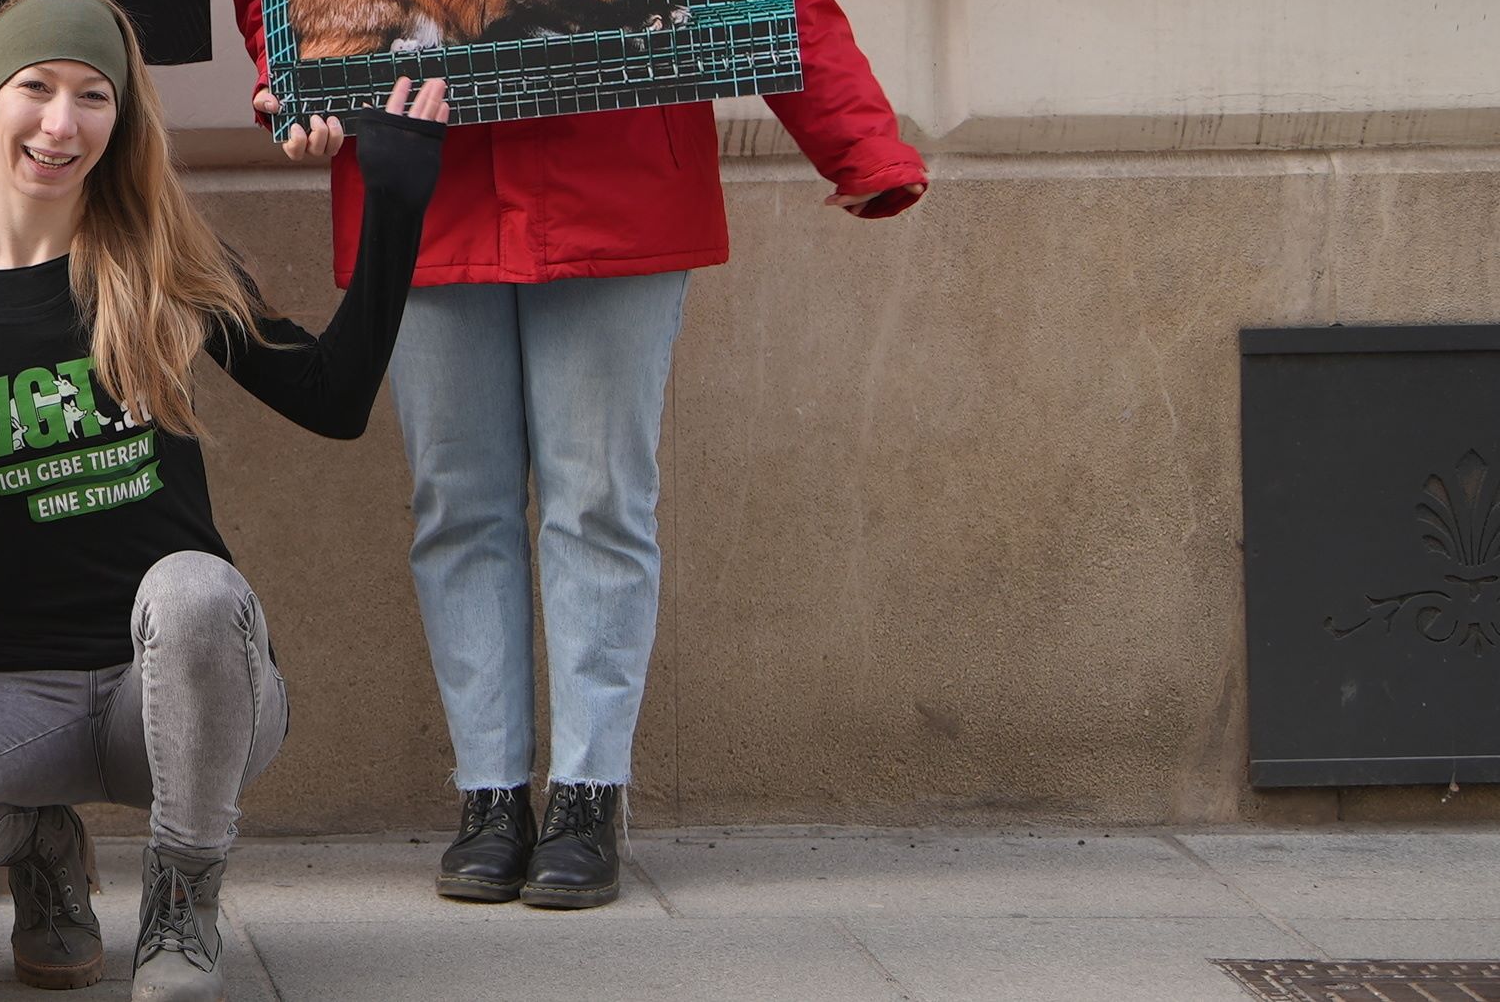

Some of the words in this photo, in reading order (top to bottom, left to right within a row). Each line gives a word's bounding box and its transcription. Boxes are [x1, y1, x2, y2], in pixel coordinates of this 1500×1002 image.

[0, 468, 31, 491] ICH
[36, 455, 84, 482] GEBE
[87, 437, 149, 471] TIEREN
[37, 491, 80, 518] EINE
[84, 472, 151, 507] STIMME
